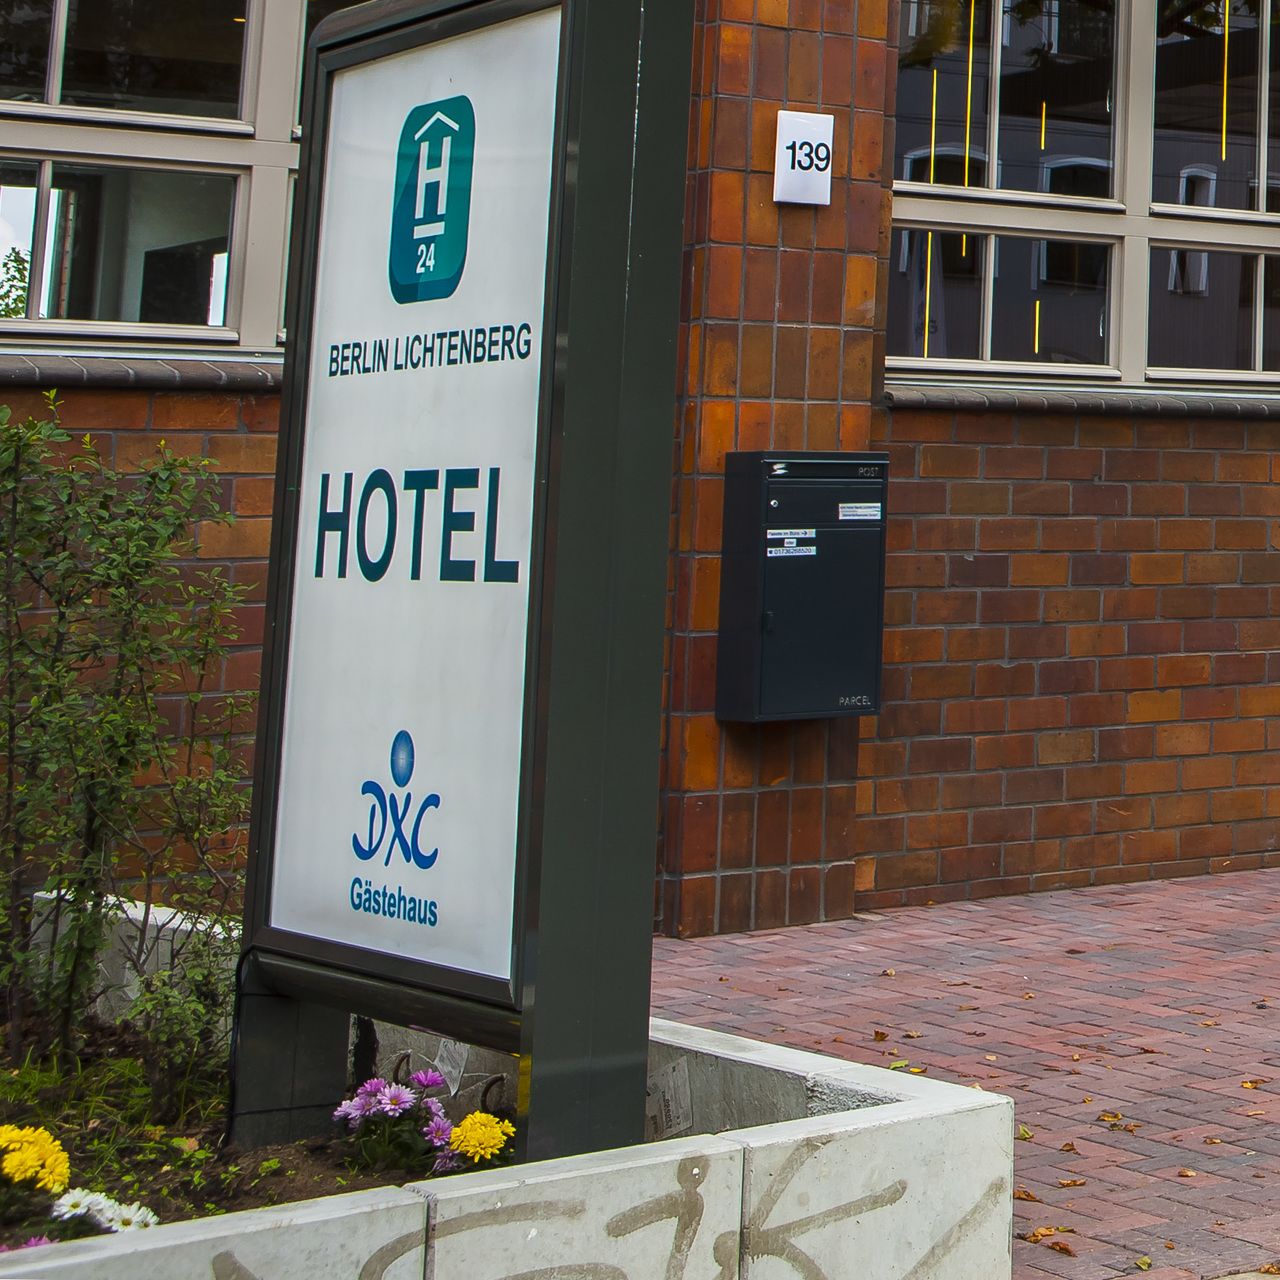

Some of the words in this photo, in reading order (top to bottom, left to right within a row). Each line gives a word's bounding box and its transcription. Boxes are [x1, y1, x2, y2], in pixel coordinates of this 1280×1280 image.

[785, 140, 831, 172] 139
[415, 242, 436, 275] 24
[327, 337, 390, 378] BERLIN
[393, 322, 532, 371] LICHTENBERG
[858, 466, 879, 477] POST
[313, 466, 521, 585] HOTEL
[839, 695, 872, 706] PARCEL
[350, 877, 438, 927] Gästehaus
